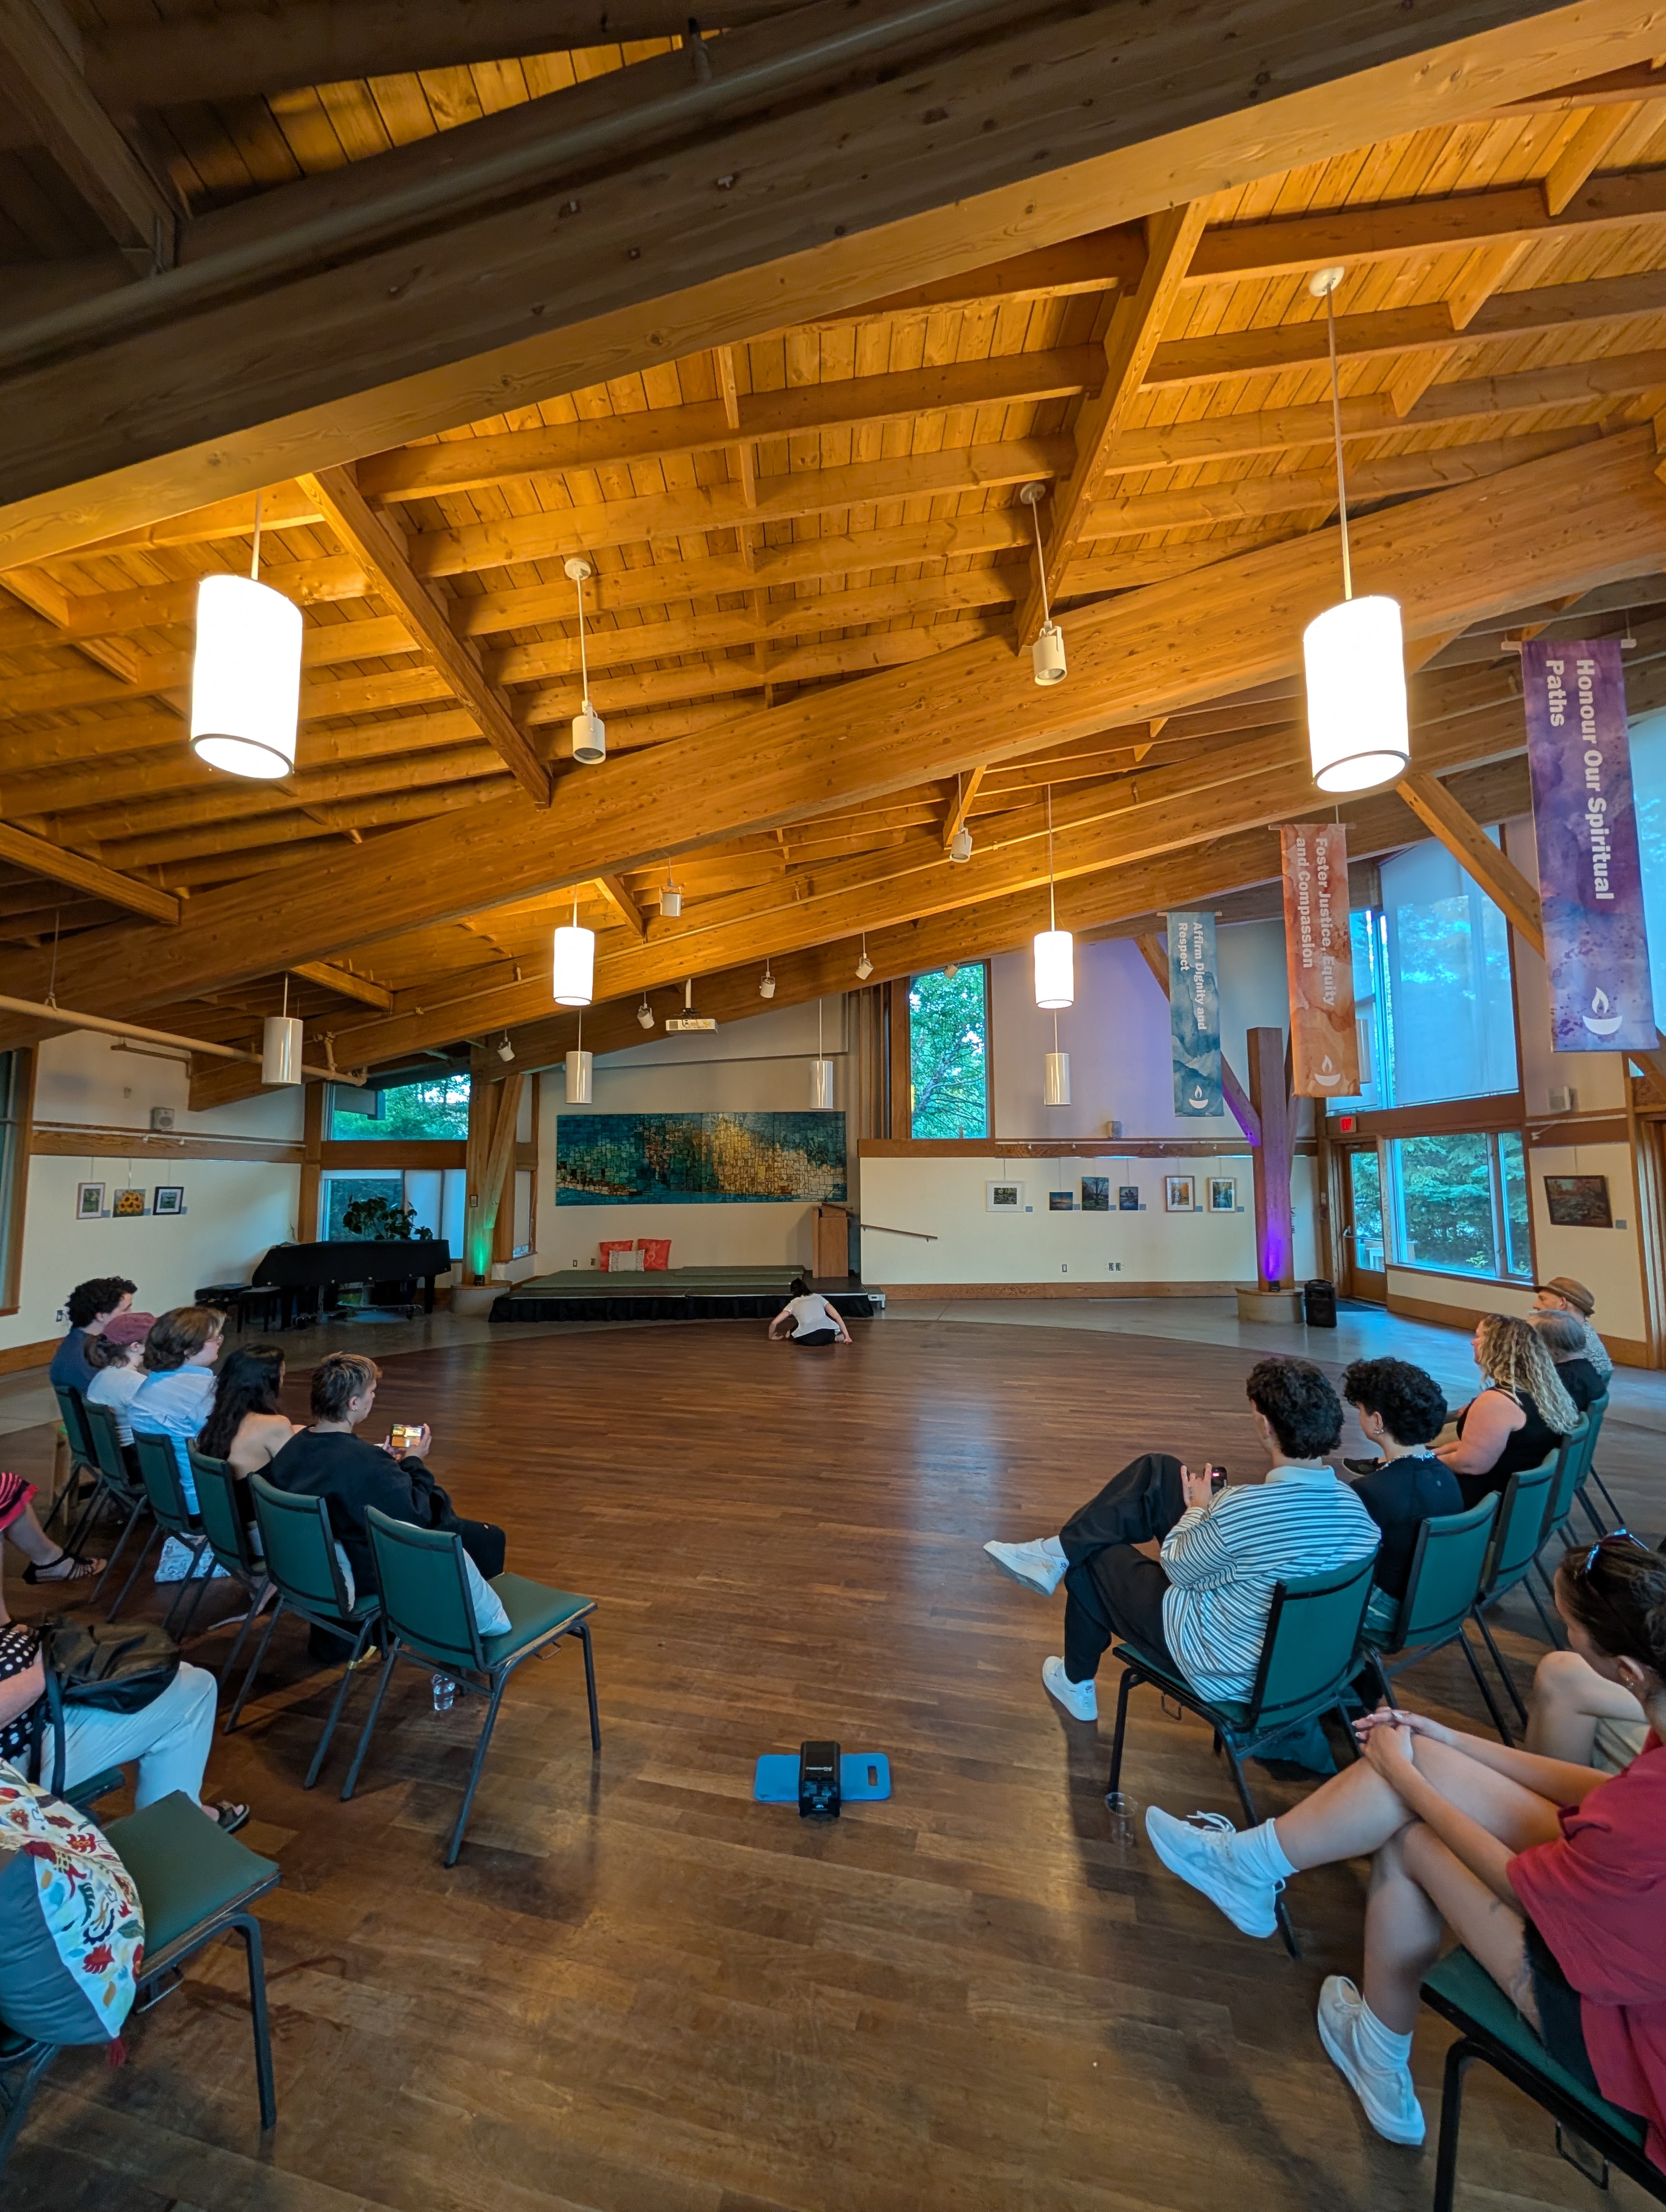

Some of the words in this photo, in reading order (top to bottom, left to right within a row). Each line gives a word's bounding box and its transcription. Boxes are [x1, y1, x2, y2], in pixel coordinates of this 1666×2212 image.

[1545, 660, 1568, 727] Paths
[1577, 659, 1597, 744] Honour
[1584, 750, 1603, 792] Our
[1296, 838, 1310, 867] and
[1315, 838, 1330, 888] Foster
[1584, 796, 1614, 900] Spiritual
[1193, 922, 1204, 959] Affirm
[1297, 870, 1315, 968] Compassion
[1318, 892, 1334, 951] Justice,
[1178, 922, 1189, 972] Respect
[1193, 963, 1206, 1005] Dignity
[1322, 956, 1337, 1006] Equity
[1196, 1008, 1207, 1030] and
